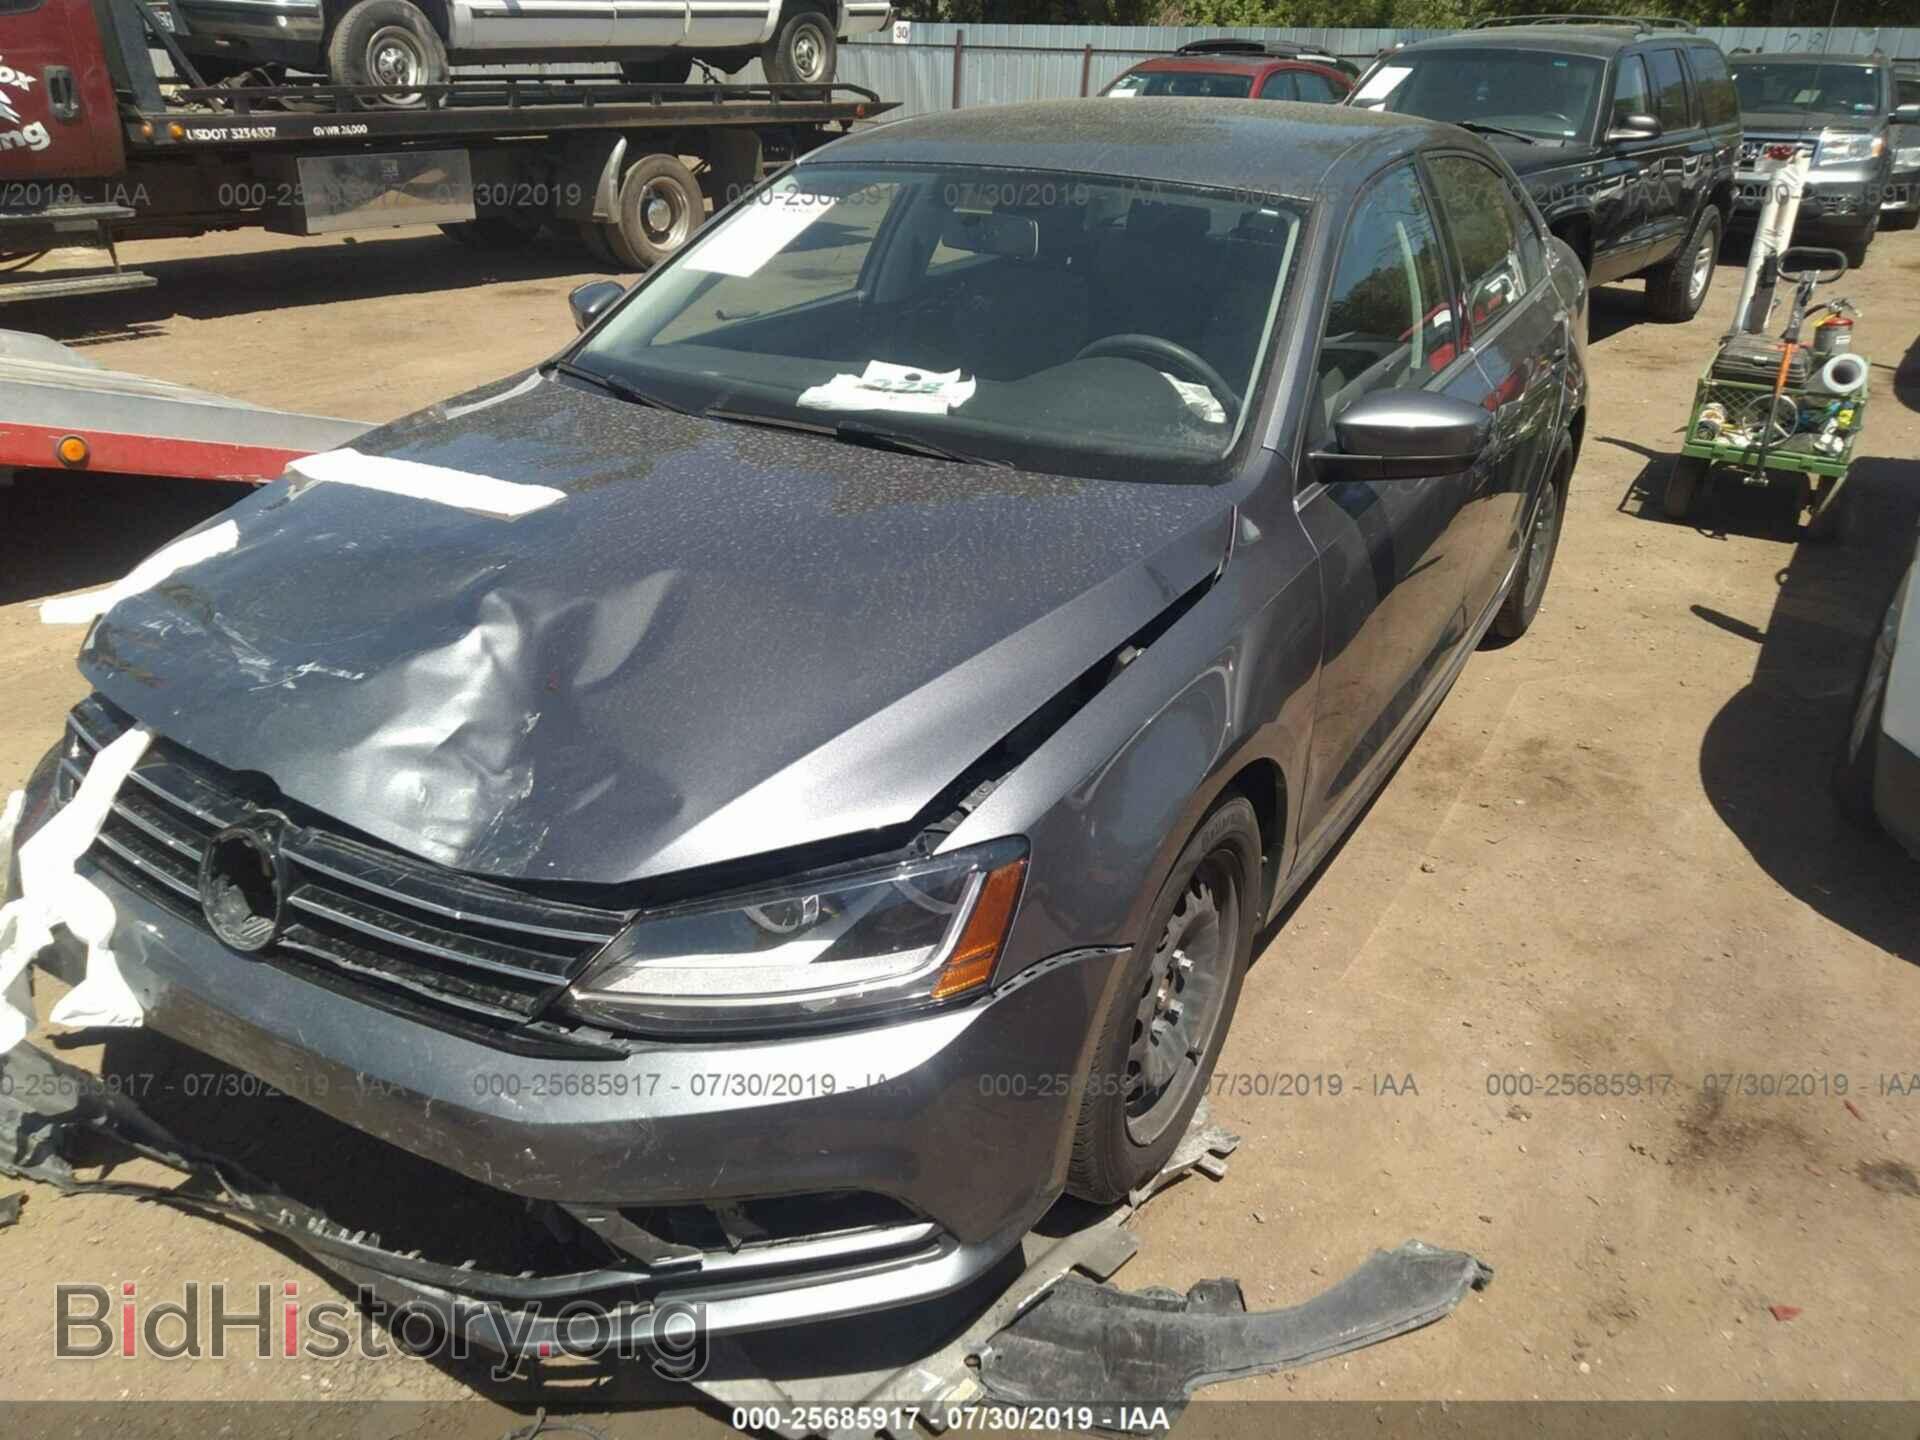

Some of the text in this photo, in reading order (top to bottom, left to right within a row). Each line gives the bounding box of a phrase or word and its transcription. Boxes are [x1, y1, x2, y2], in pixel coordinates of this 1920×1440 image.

[896, 26, 908, 39] 30
[0, 65, 38, 92] ox
[186, 127, 228, 140] USDOT
[313, 125, 340, 137] GVWR
